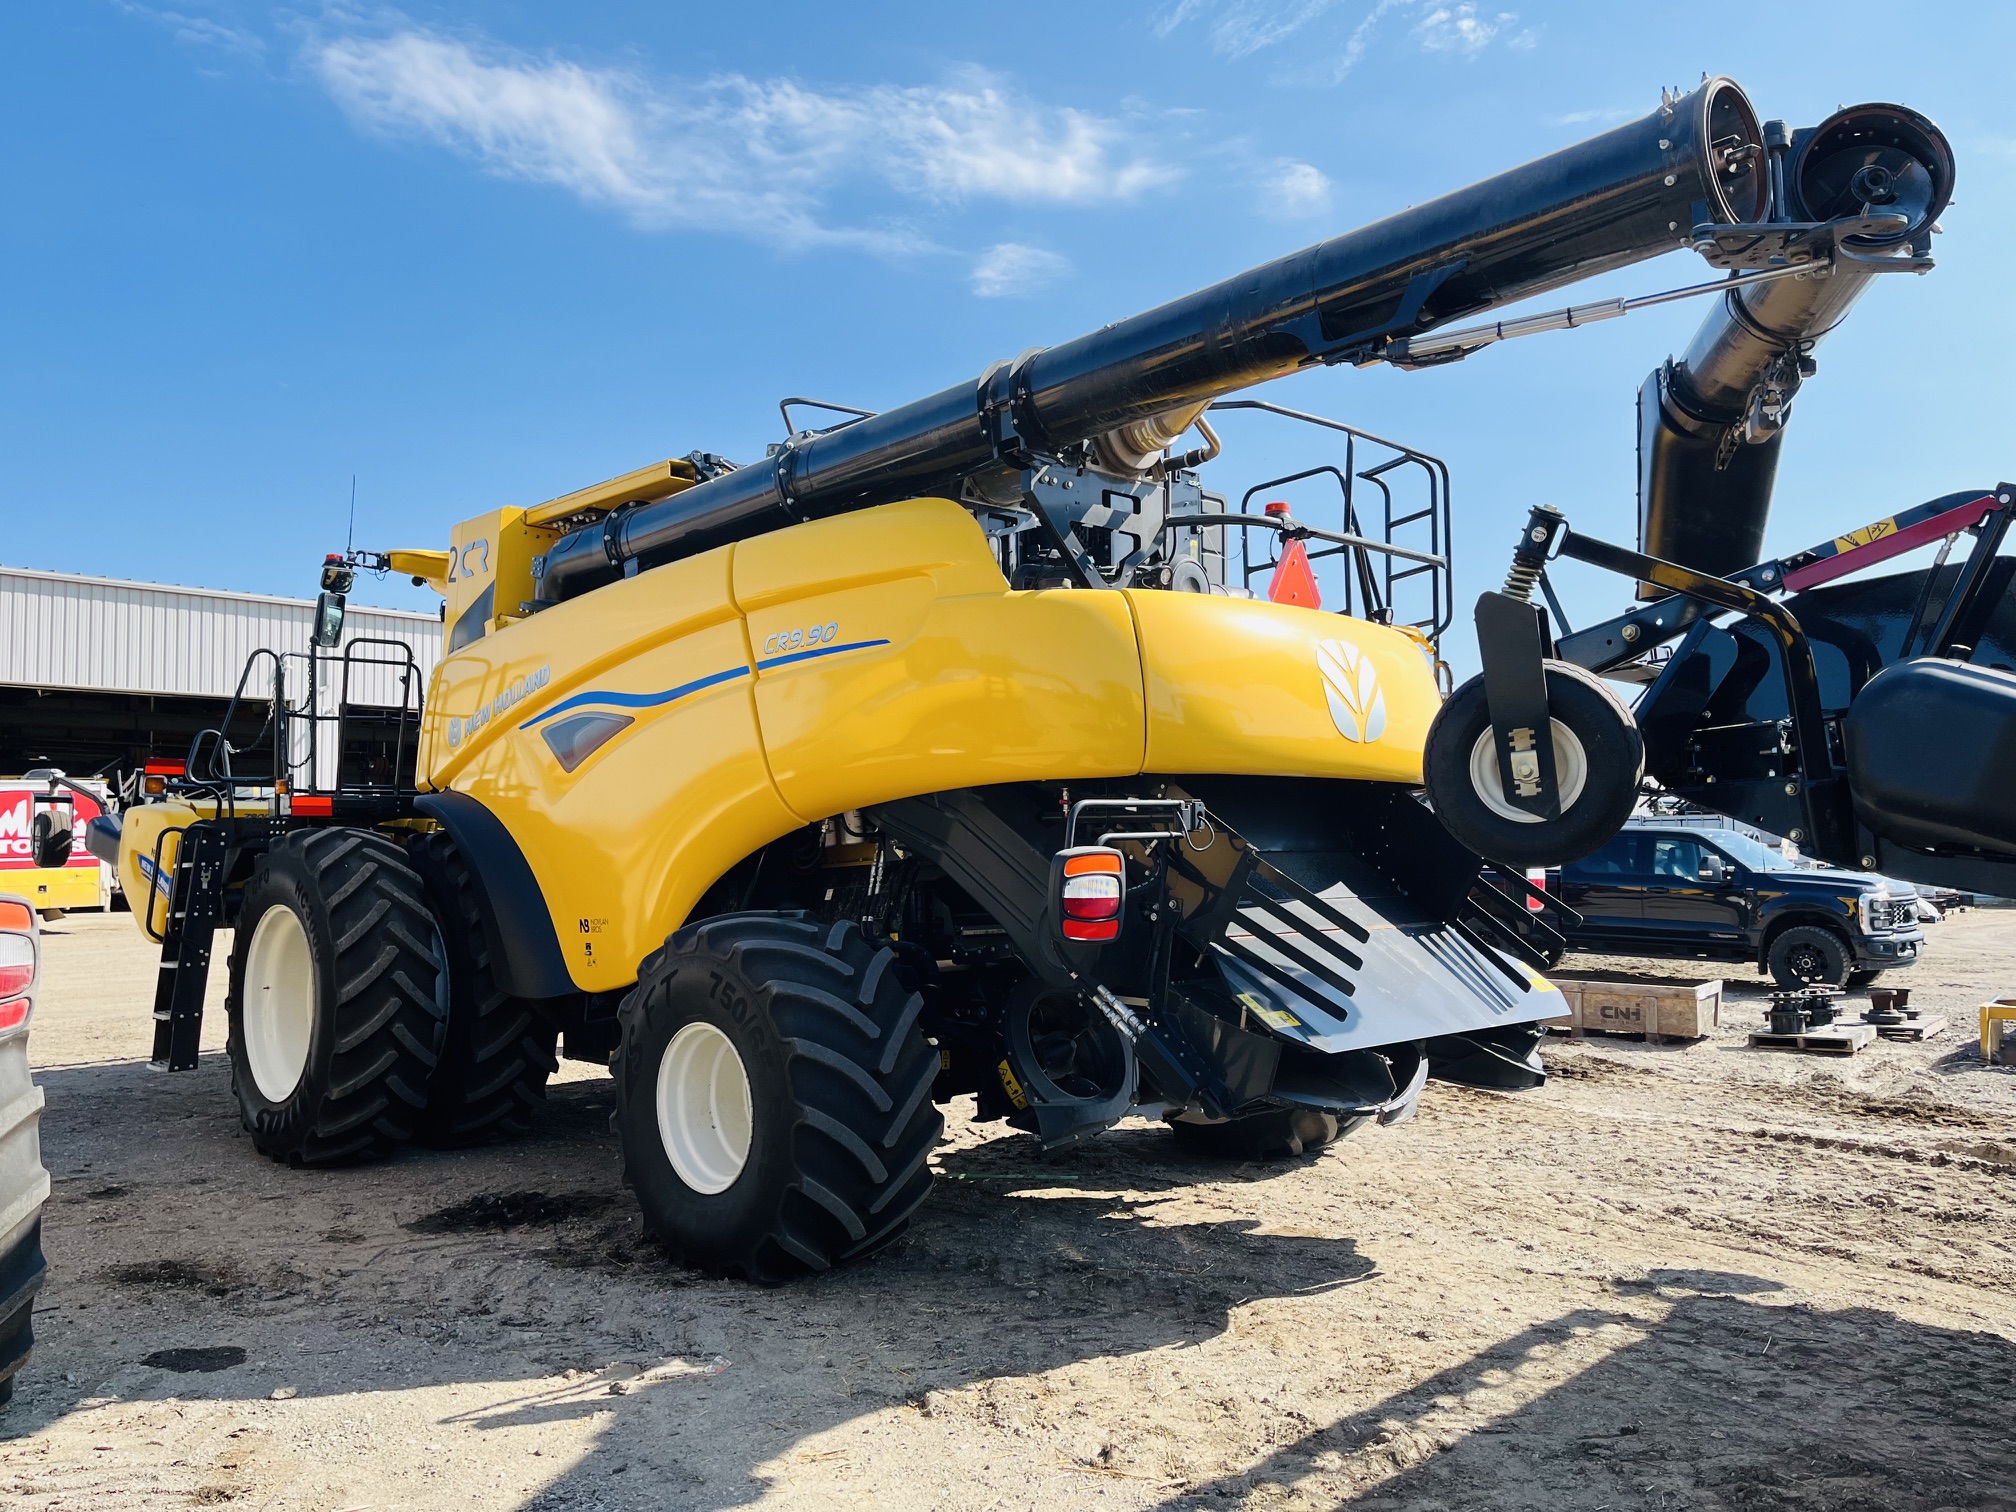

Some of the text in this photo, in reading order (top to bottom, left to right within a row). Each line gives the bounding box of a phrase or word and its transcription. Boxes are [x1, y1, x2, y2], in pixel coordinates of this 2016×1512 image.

[764, 622, 838, 655] CR9.90
[464, 665, 550, 738] NEW HOLLAND
[1600, 1003, 1641, 1021] CNH
